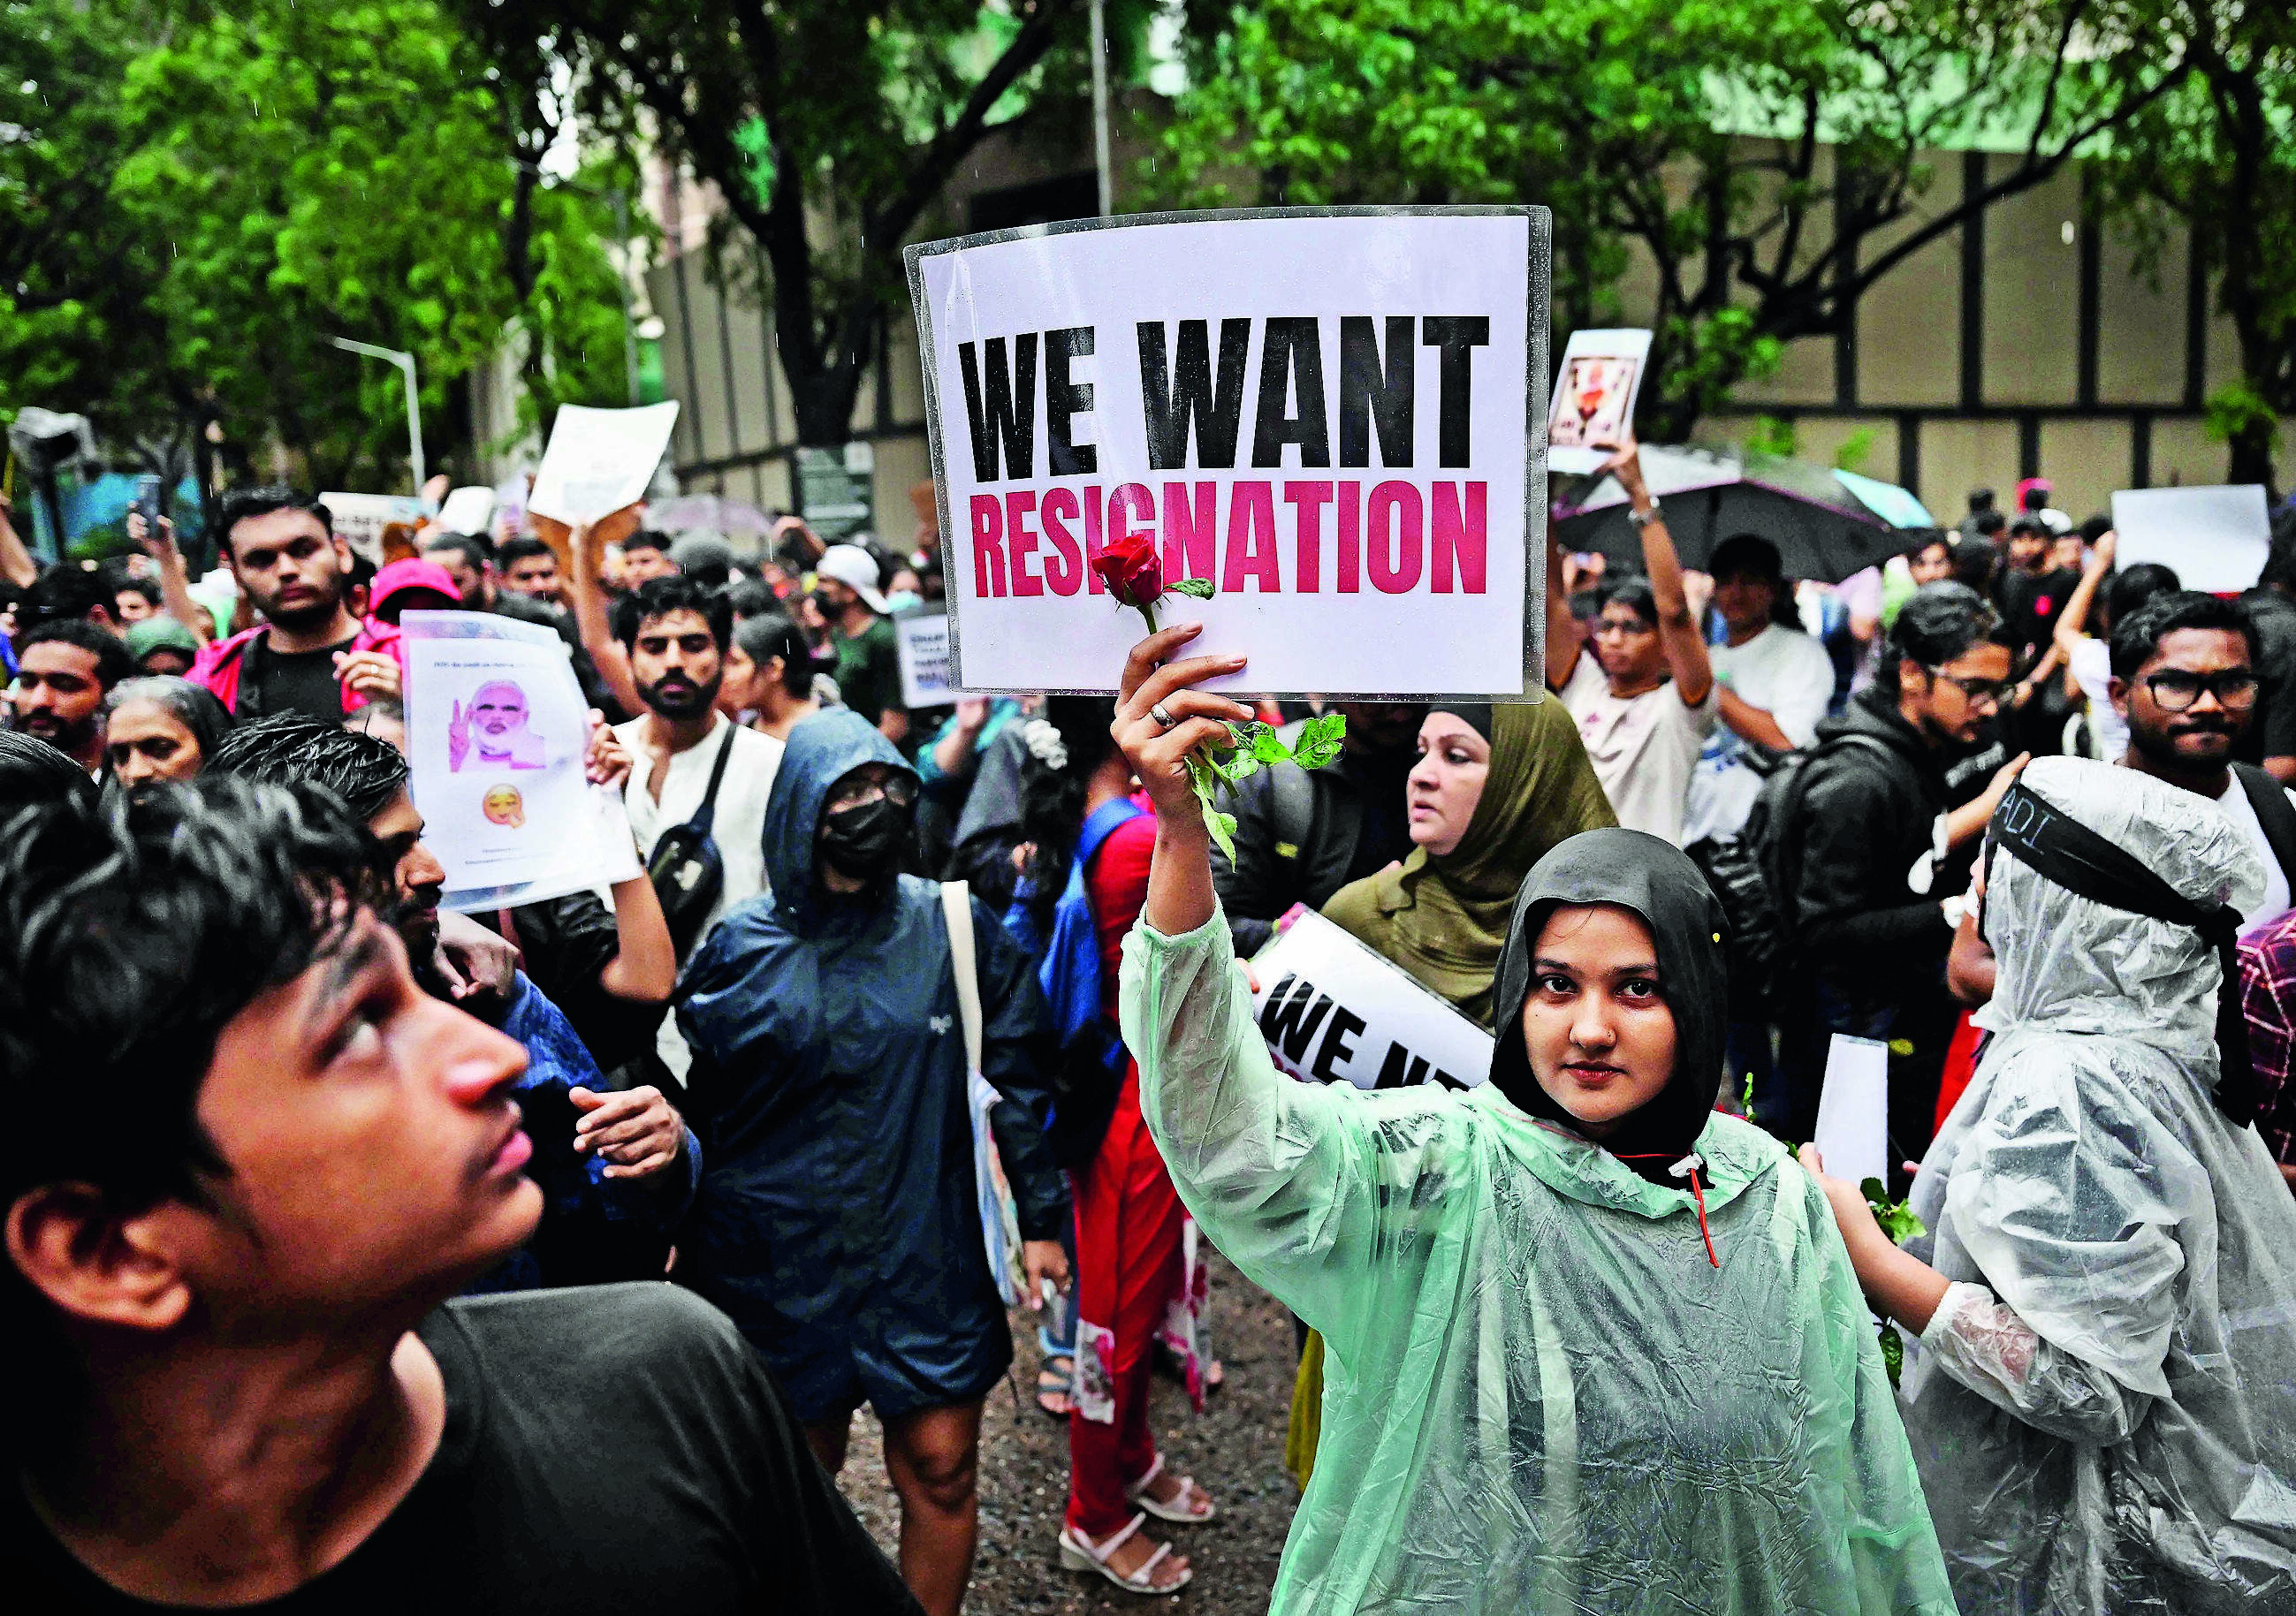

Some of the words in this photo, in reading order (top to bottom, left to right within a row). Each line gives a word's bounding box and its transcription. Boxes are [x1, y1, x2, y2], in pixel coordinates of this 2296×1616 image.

[958, 325, 1098, 483] WE
[1137, 315, 1490, 471] WANT
[1258, 970, 1367, 1086] WE
